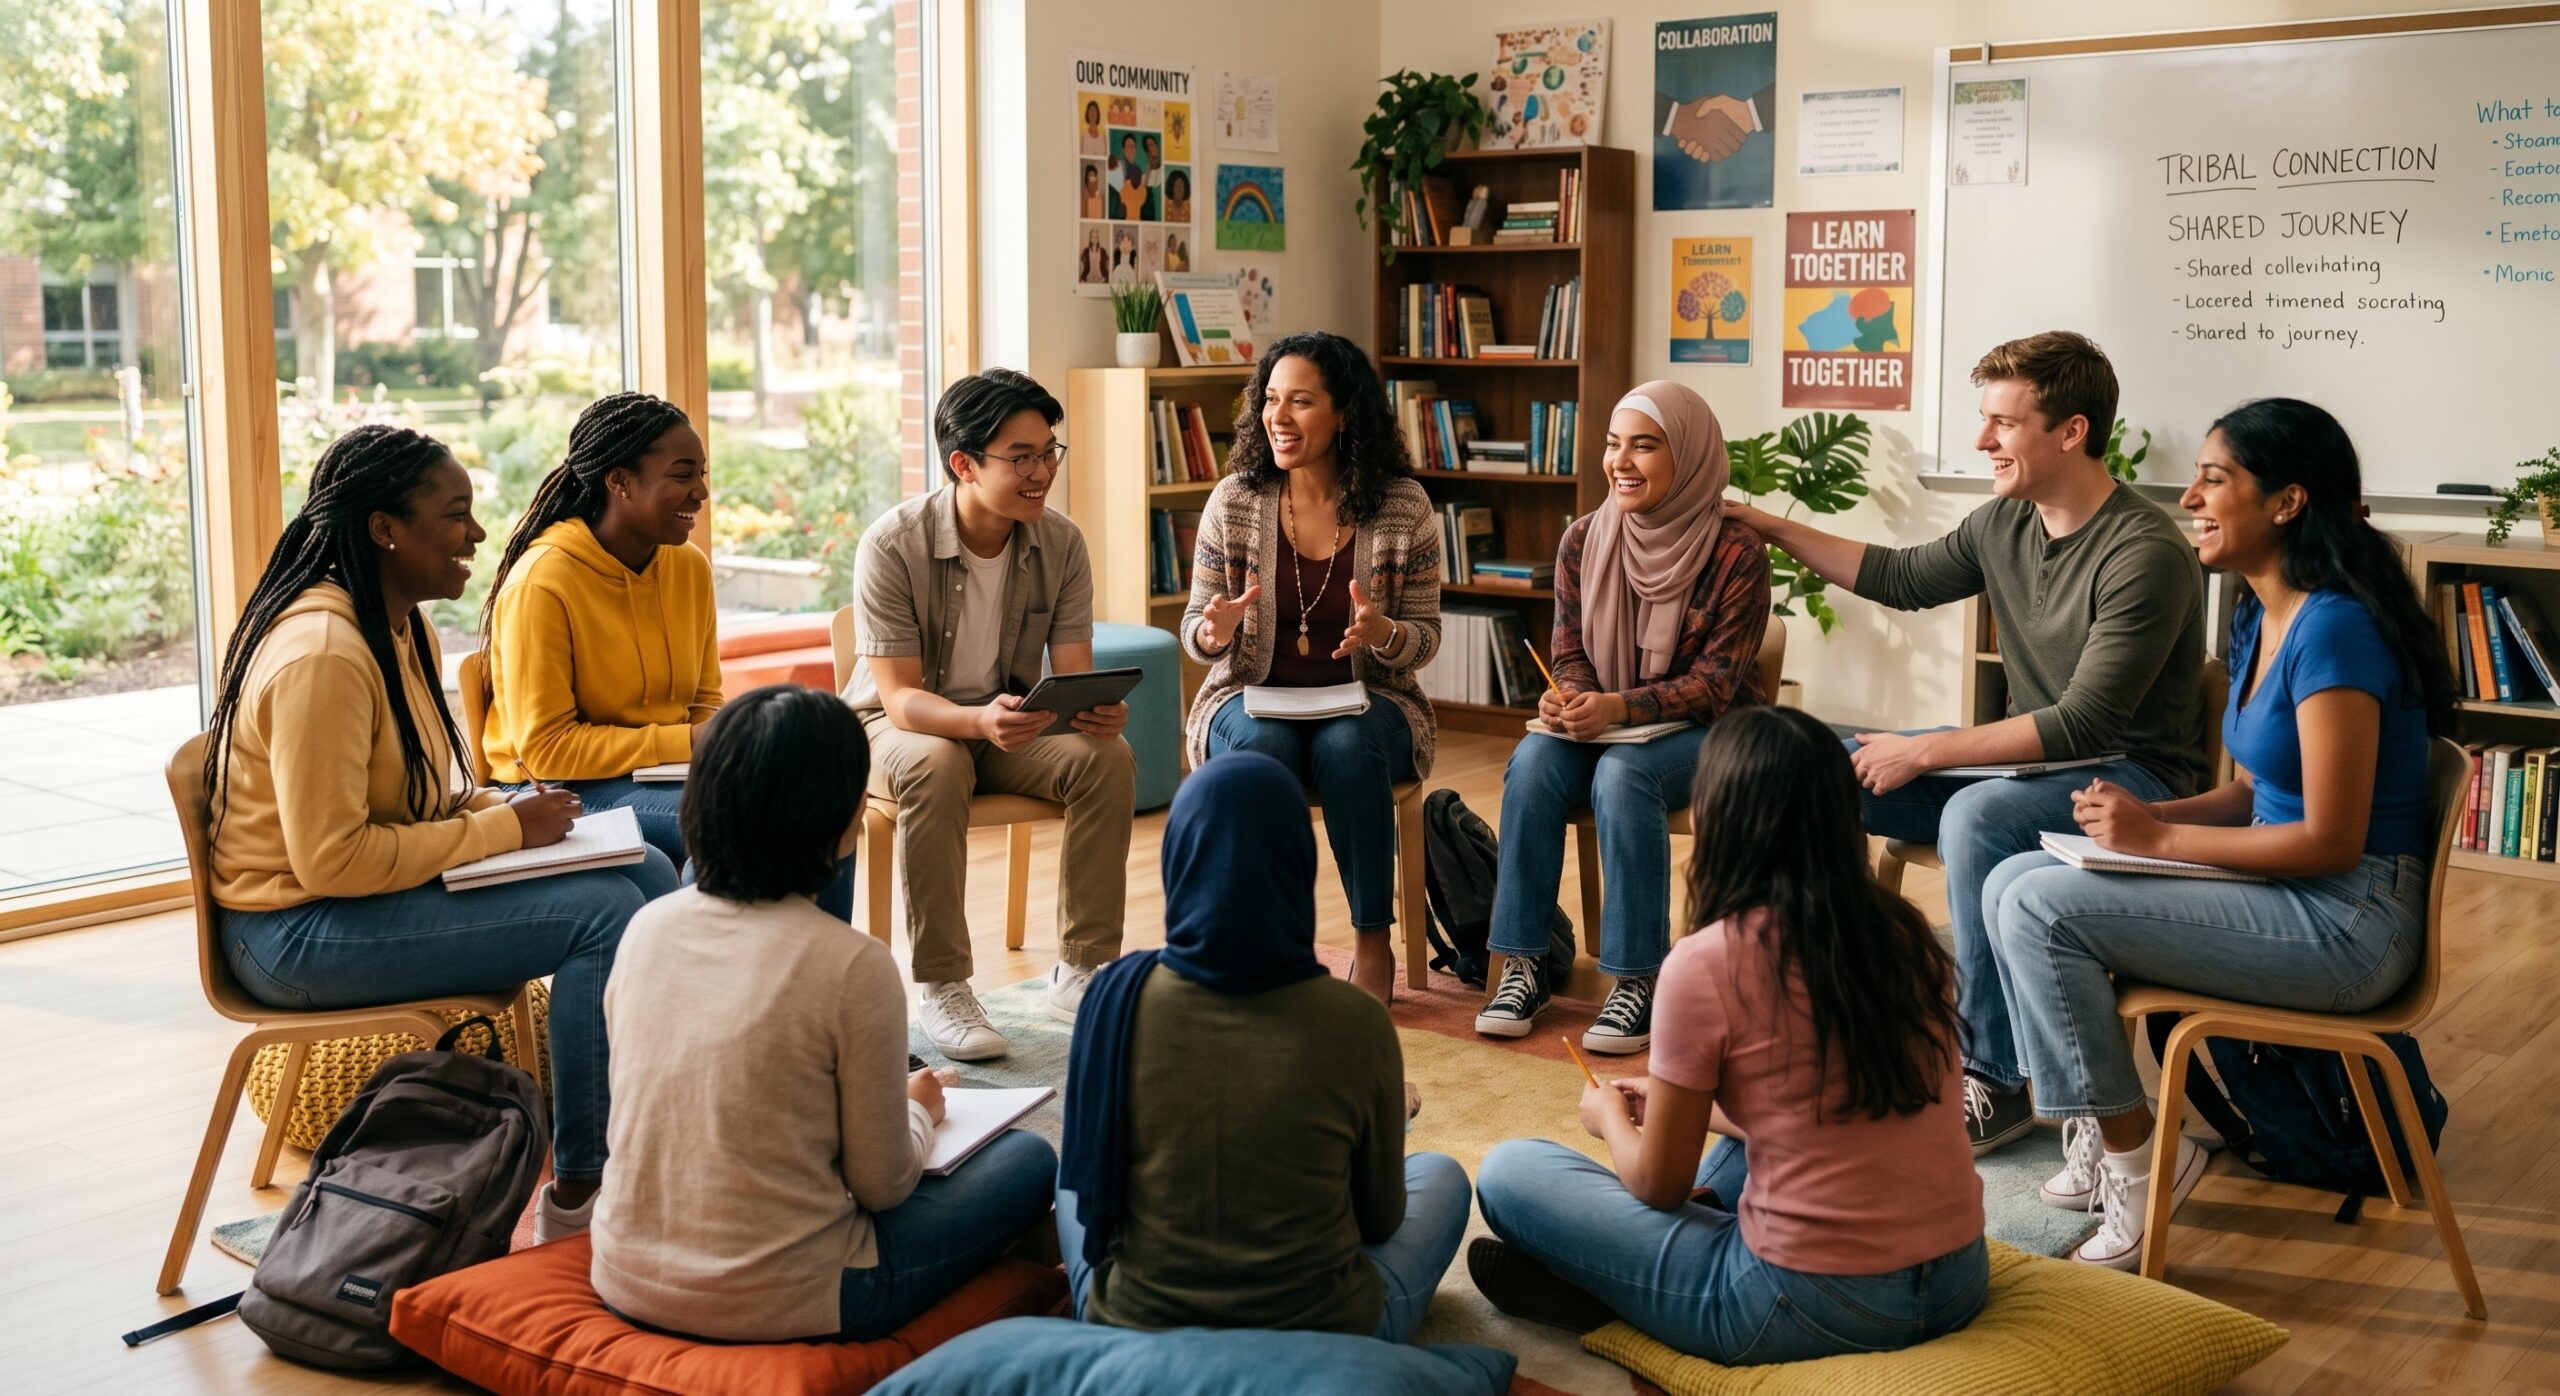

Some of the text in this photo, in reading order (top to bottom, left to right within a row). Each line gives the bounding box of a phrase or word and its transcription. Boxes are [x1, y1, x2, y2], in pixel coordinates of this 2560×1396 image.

[1658, 22, 1773, 50] COLLABORATION
[1076, 60, 1190, 94] OUR COMMUNITY
[2477, 99, 2533, 123] What
[2157, 143, 2437, 184] TRIBAL CONNECTION
[2502, 188, 2560, 206] Recom
[1812, 220, 1885, 250] LEARN
[2168, 208, 2408, 244] SHARED JOURNEY
[1691, 244, 1732, 256] LEARN
[1790, 252, 1906, 282] TOGETHER
[2187, 257, 2252, 277] Shared
[2496, 264, 2555, 283] Monic
[2185, 290, 2446, 323] Locered timened socrating
[2185, 322, 2366, 350] Shared to journey.
[1788, 357, 1904, 388] TOGETHER
